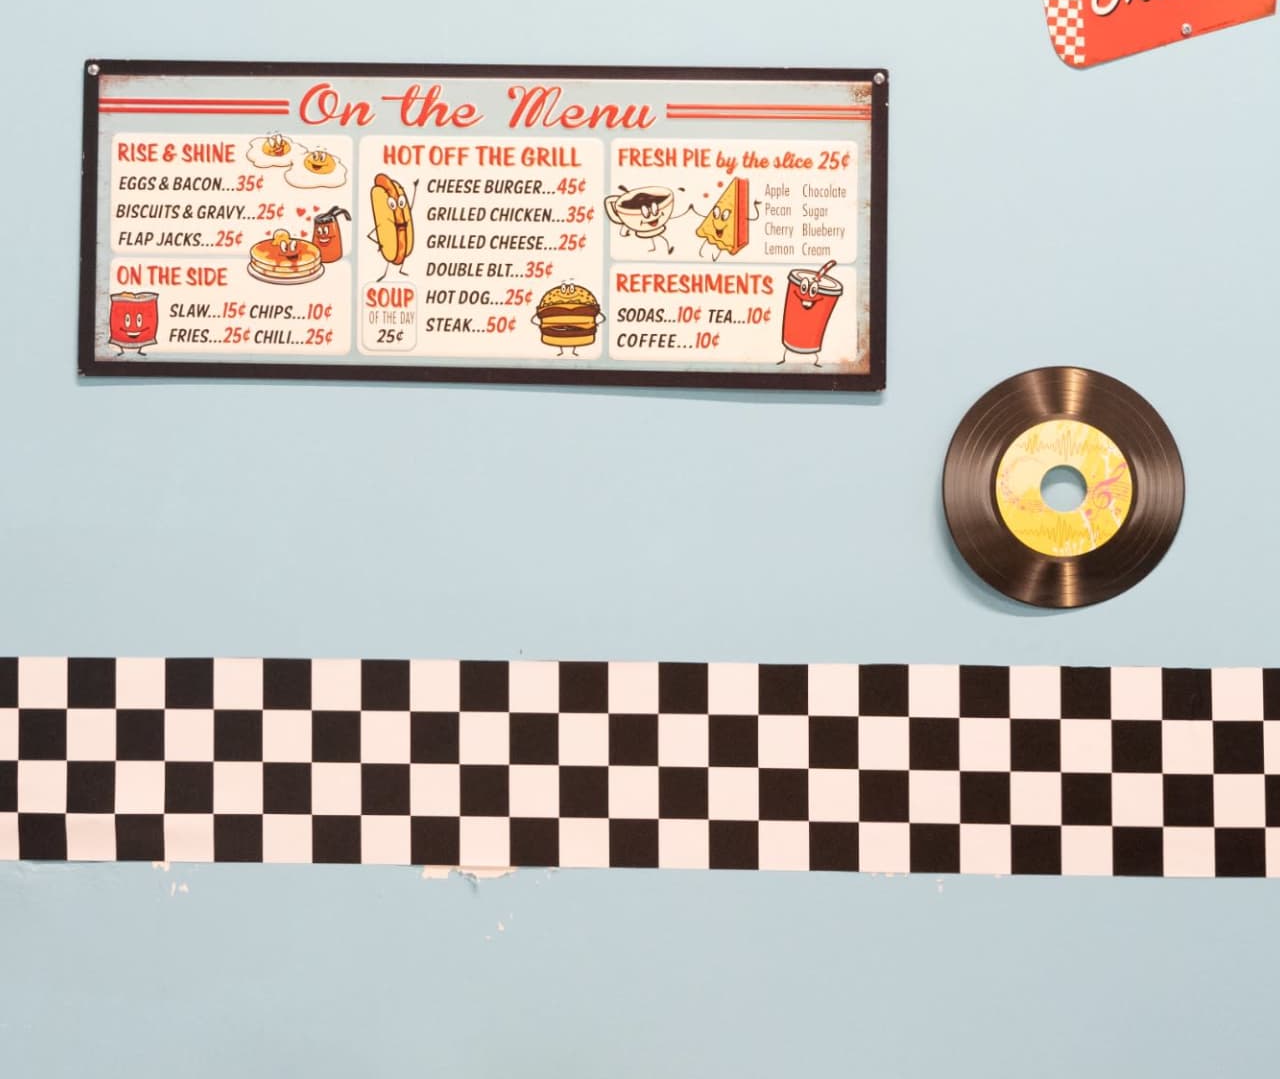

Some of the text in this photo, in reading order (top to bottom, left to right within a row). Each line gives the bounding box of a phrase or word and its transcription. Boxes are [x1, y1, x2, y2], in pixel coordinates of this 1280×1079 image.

[299, 83, 657, 130] On the Menu
[117, 141, 236, 164] RISE & SHINE
[383, 144, 582, 167] HOT OFF THE GRILL
[618, 147, 850, 174] FRESH PIE by the slice 25¢
[119, 176, 155, 191] EGGS
[158, 176, 170, 191] &
[427, 179, 480, 193] CHEESE
[802, 184, 847, 198] Chocolate
[765, 183, 790, 200] Apple
[116, 203, 179, 219] BISCUITS
[182, 204, 193, 219] &
[427, 207, 485, 221] GRILLED
[765, 202, 792, 216] Pecan
[802, 203, 828, 220] Sugar
[765, 222, 794, 238] Cherry
[802, 223, 845, 238] Blueberry
[118, 231, 154, 246] FLAP
[427, 234, 485, 249] GRILLED
[764, 241, 794, 255] Lemon
[802, 242, 831, 256] Cream
[116, 264, 228, 286] ON THE SIDE
[426, 262, 484, 277] DOUBLE
[616, 273, 774, 295] REFRESHMENTS
[365, 287, 414, 308] SOUP
[425, 290, 457, 305] HOT
[369, 311, 415, 324] OF THE DAY
[376, 329, 404, 343] 25¢
